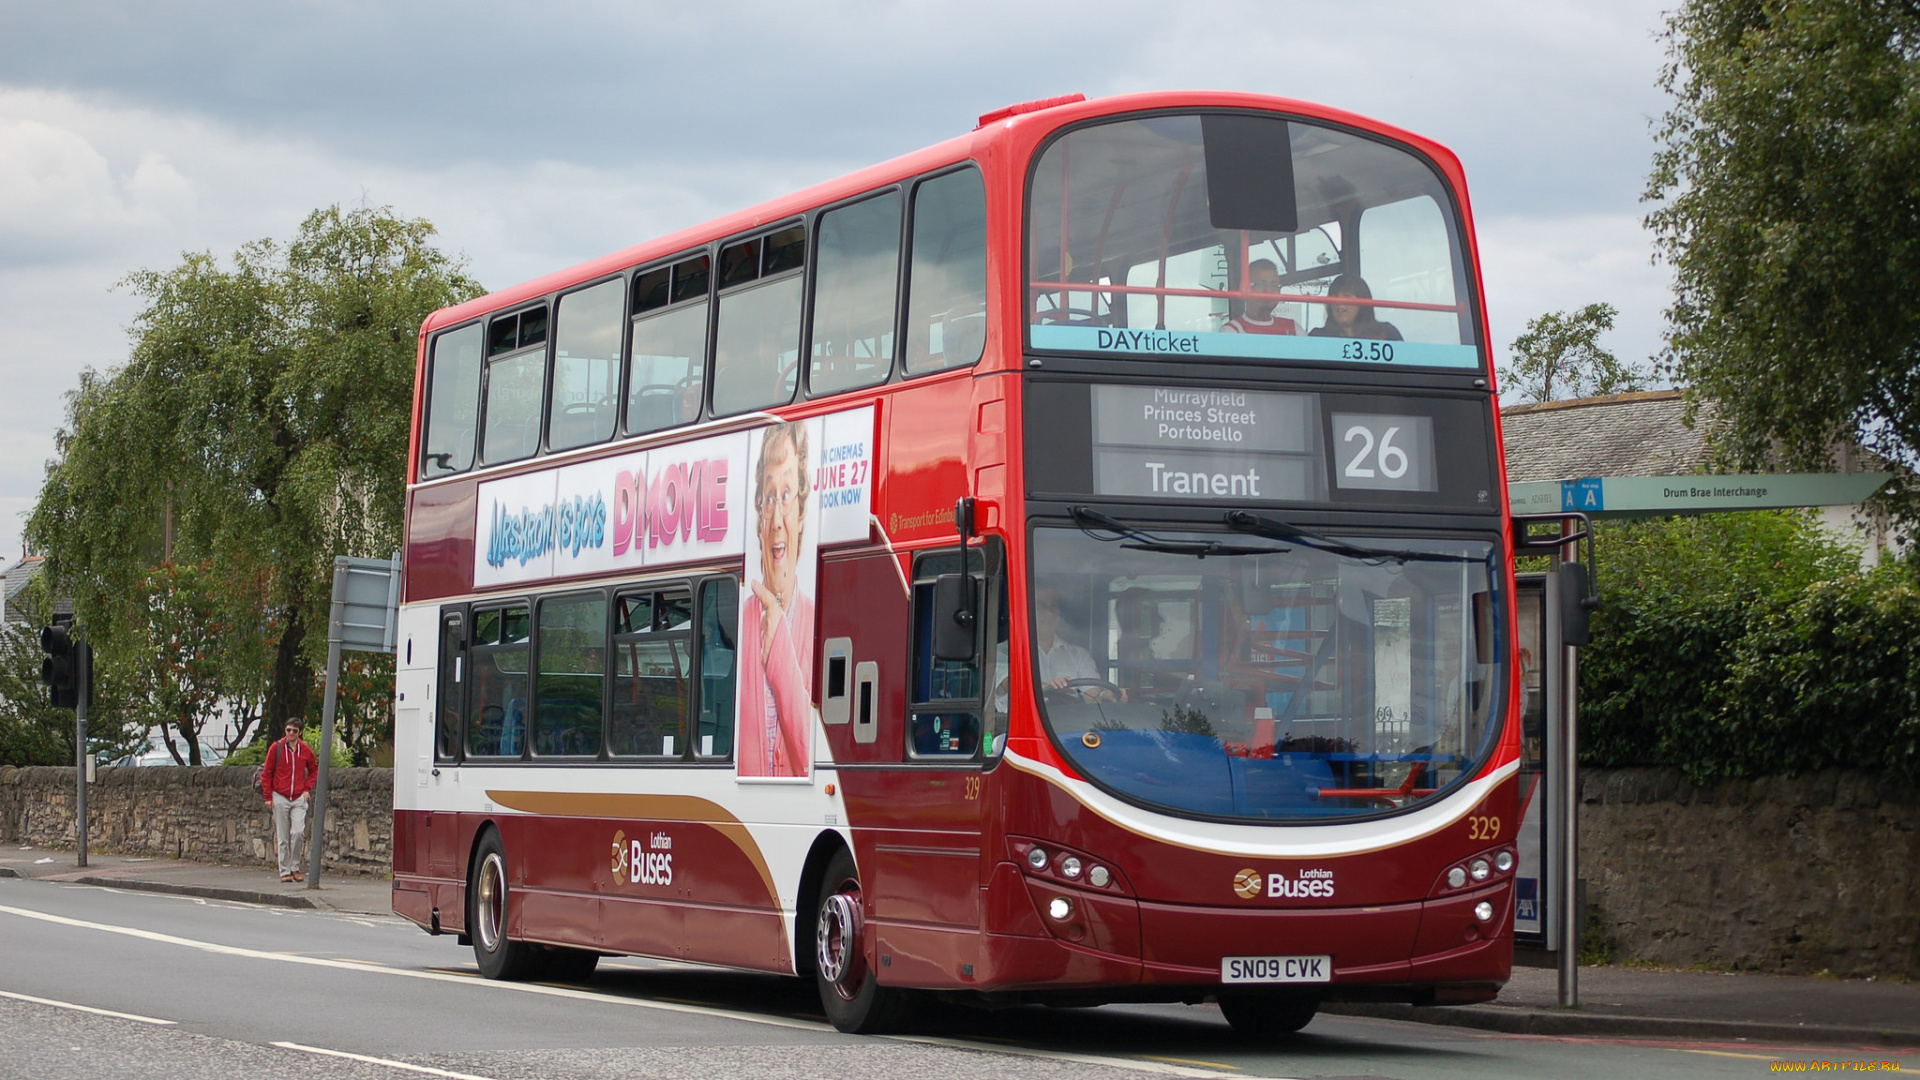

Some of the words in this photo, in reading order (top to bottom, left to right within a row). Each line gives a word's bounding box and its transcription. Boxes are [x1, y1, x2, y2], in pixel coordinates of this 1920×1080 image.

[1342, 341, 1394, 362] £3.50
[1154, 388, 1245, 408] Murrayfield
[1144, 405, 1201, 422] Princes
[1207, 408, 1256, 425] Street
[1159, 423, 1242, 442] Portobello
[829, 442, 863, 462] CINEMAS
[1344, 425, 1408, 479] 26
[813, 463, 846, 491] JUNE
[850, 460, 868, 485] 27
[1145, 462, 1260, 497] Tranent
[841, 487, 862, 506] NOW
[1566, 490, 1573, 507] A
[1584, 489, 1597, 506] A
[1663, 487, 1688, 498] Drum
[1690, 487, 1711, 497] Brae
[1713, 486, 1768, 498] Interchange
[899, 514, 925, 531] Transport
[964, 776, 981, 800] 329
[1468, 816, 1500, 840] 329
[650, 831, 672, 849] Lothian
[631, 840, 673, 886] Buses
[1300, 868, 1333, 878] Lothian
[1267, 873, 1335, 898] Buses
[1230, 959, 1280, 979] SN09
[1285, 958, 1322, 978] CVK
